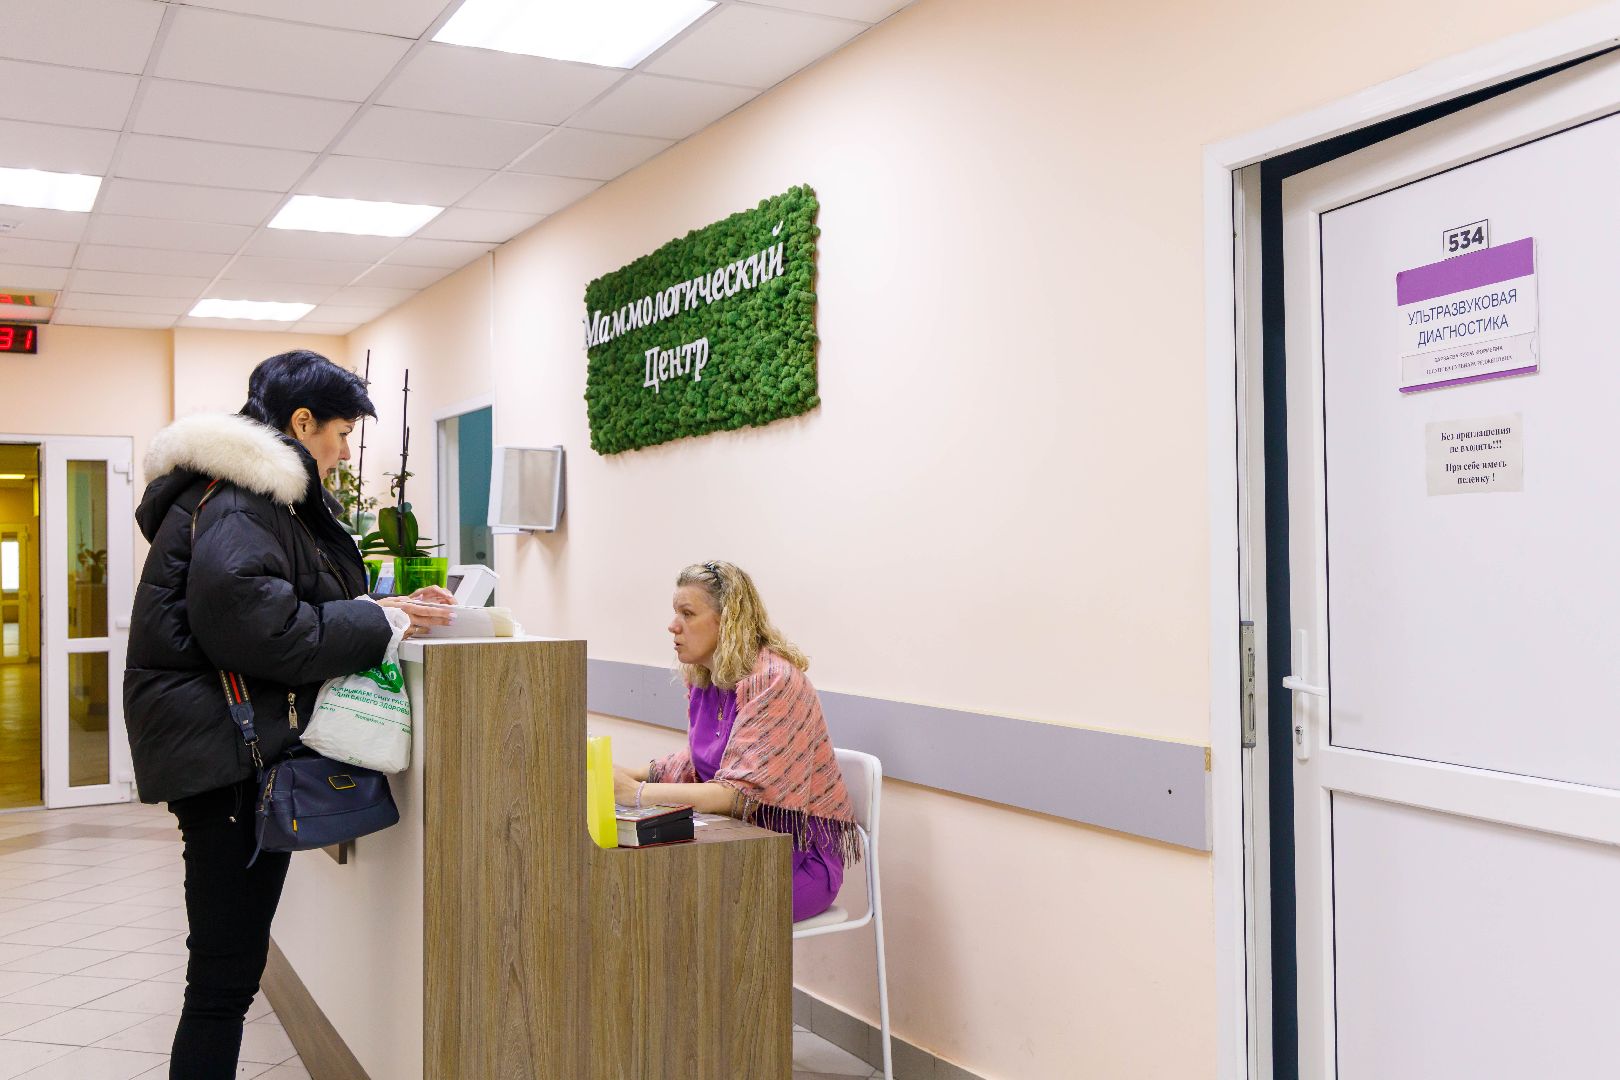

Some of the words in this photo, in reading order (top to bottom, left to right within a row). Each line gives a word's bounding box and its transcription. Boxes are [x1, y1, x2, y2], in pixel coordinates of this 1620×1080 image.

[1448, 226, 1485, 253] 534
[582, 220, 785, 350] Маммологический
[1407, 288, 1517, 326] УЛЬТРАЗВУКОВАЯ
[1417, 314, 1509, 349] ДИАГНОСТИКА
[643, 337, 709, 393] Центр
[1441, 432, 1454, 441] Без
[1456, 427, 1511, 441] приглашения
[1449, 446, 1459, 454] не
[1460, 440, 1502, 453] входить!!!
[1445, 463, 1462, 473] При
[1463, 461, 1480, 471] себе
[1482, 460, 1507, 469] иметь
